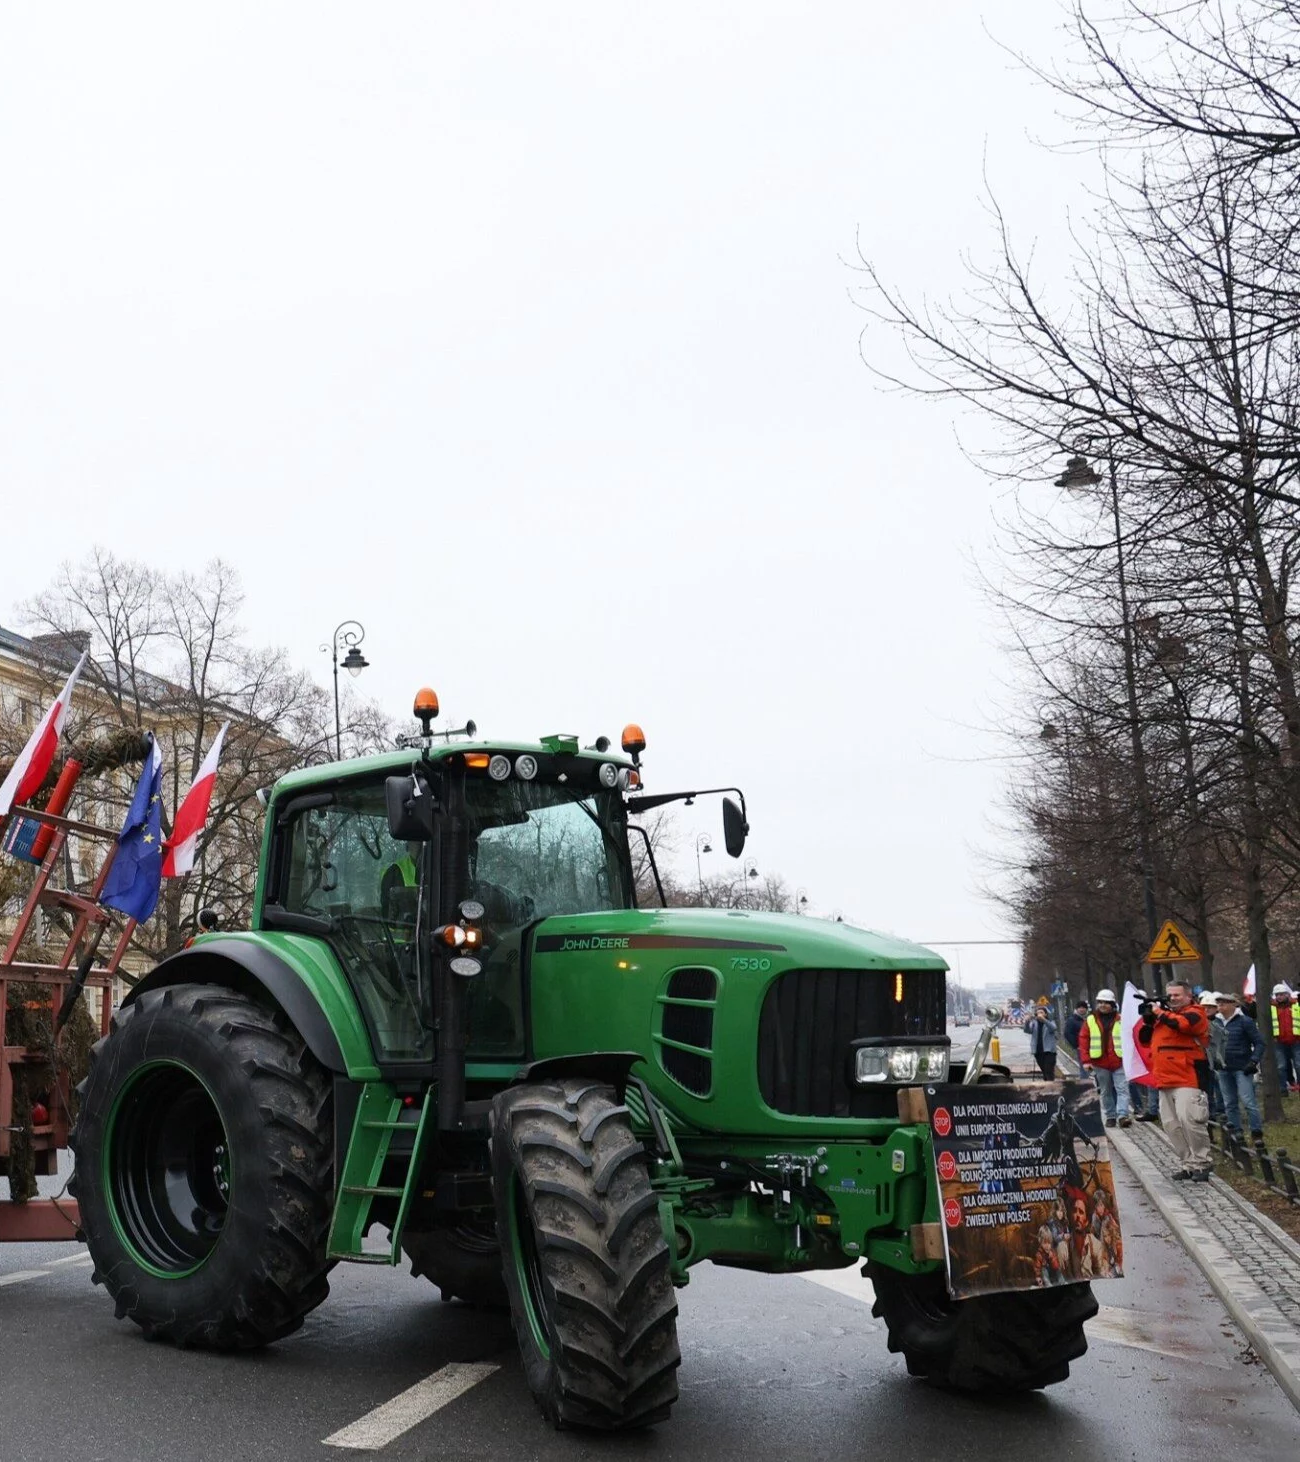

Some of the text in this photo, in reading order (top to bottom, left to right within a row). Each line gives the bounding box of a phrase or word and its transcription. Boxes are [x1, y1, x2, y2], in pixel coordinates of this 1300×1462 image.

[560, 937, 630, 950] JOHN DEERE
[730, 957, 772, 971] 7530
[953, 1105, 966, 1117] DLA
[967, 1104, 996, 1117] POLITYKI
[996, 1103, 1031, 1115] ZIELONEGO
[935, 1117, 949, 1127] STOP
[955, 1123, 1016, 1136] UNII EUROPEJSKIEJ
[958, 1151, 972, 1163] DLA
[972, 1149, 1001, 1162] IMPORTU
[940, 1161, 954, 1170] STOP
[1035, 1165, 1040, 1176] Z
[1040, 1164, 1067, 1176] UKRAINY
[963, 1195, 977, 1207] DLA
[977, 1192, 1025, 1206] OGRANICZENIA
[945, 1208, 959, 1218] STOP
[965, 1210, 1031, 1228] ZWIERZĄT W POLSCE
